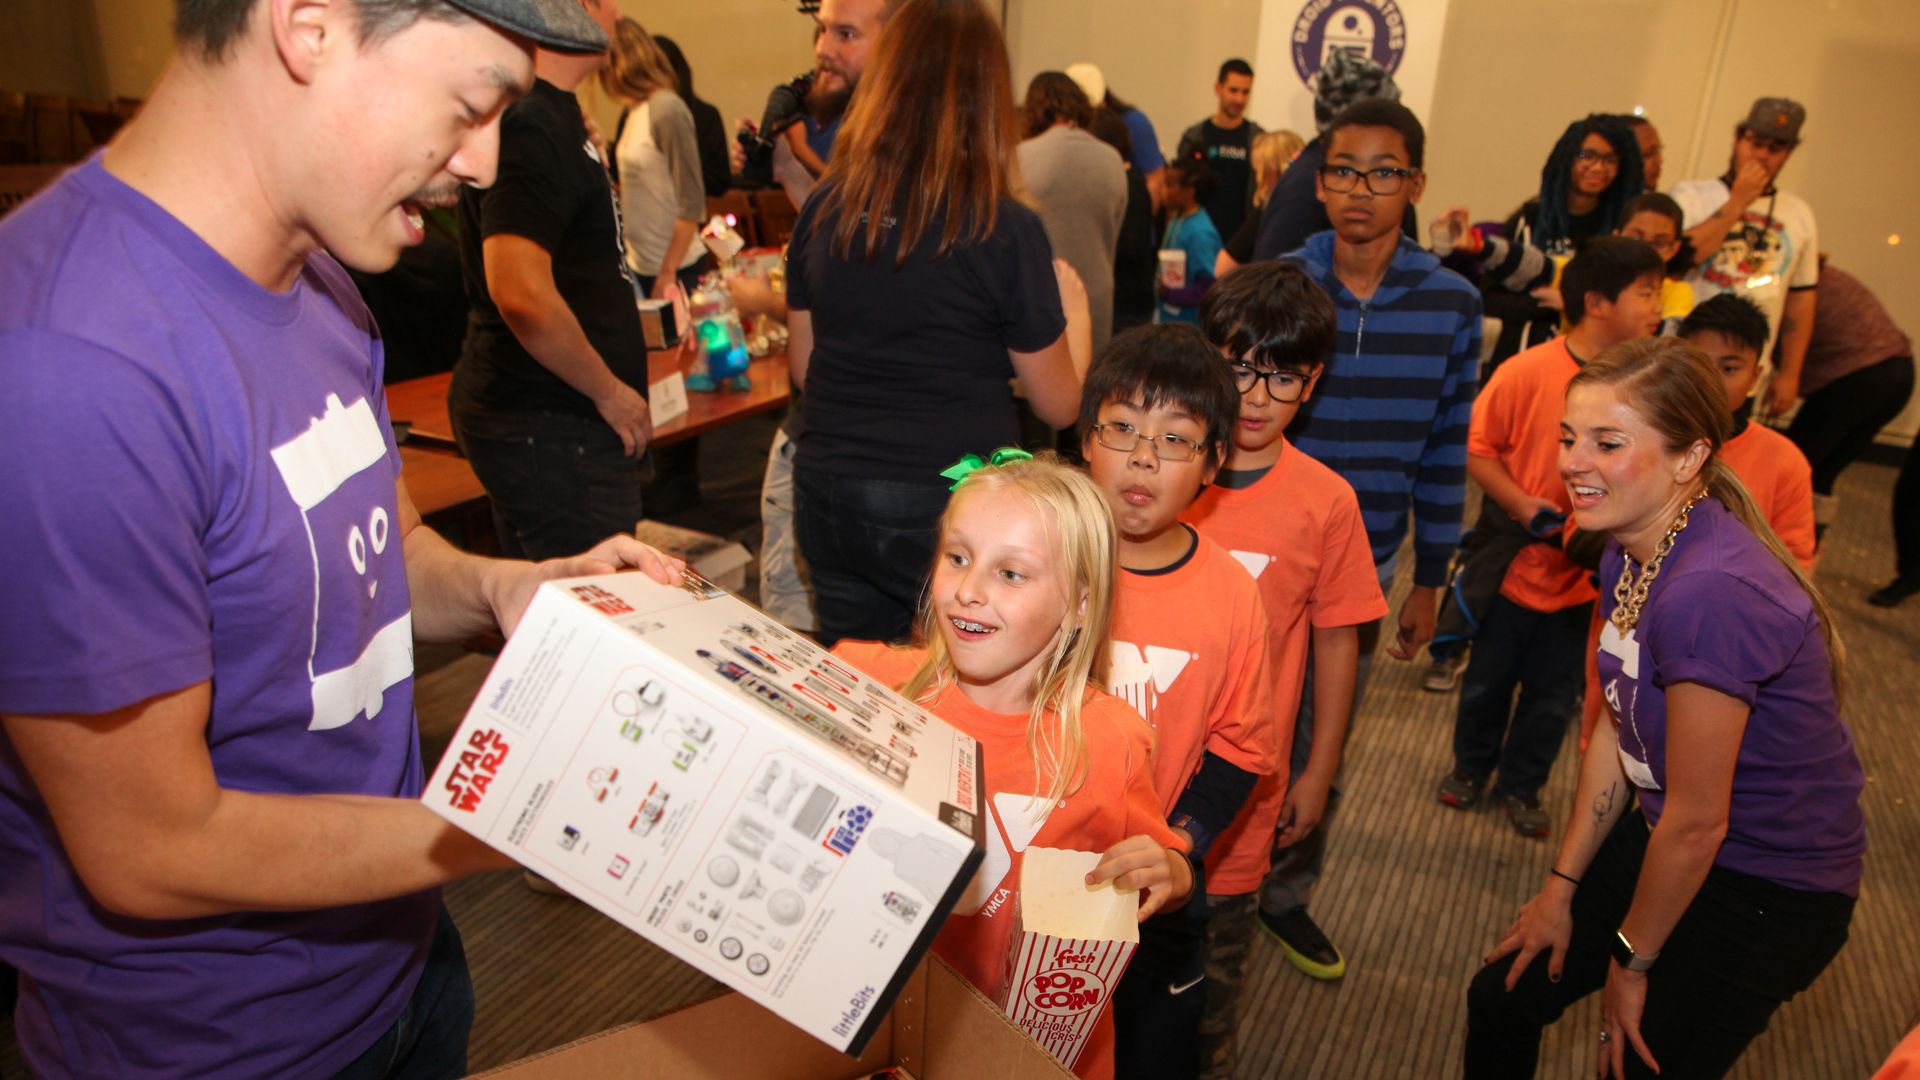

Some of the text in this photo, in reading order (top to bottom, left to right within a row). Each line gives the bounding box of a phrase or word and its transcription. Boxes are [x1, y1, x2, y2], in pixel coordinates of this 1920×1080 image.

[445, 728, 495, 806] STAR
[457, 733, 510, 814] WARS
[981, 887, 1011, 919] YMCA
[1055, 949, 1096, 968] fresh
[1034, 972, 1086, 994] POP
[1034, 988, 1100, 1011] CORN
[831, 985, 875, 1038] littleBits
[1019, 1017, 1074, 1033] DELICIOUS
[1050, 1030, 1082, 1043] CRISP
